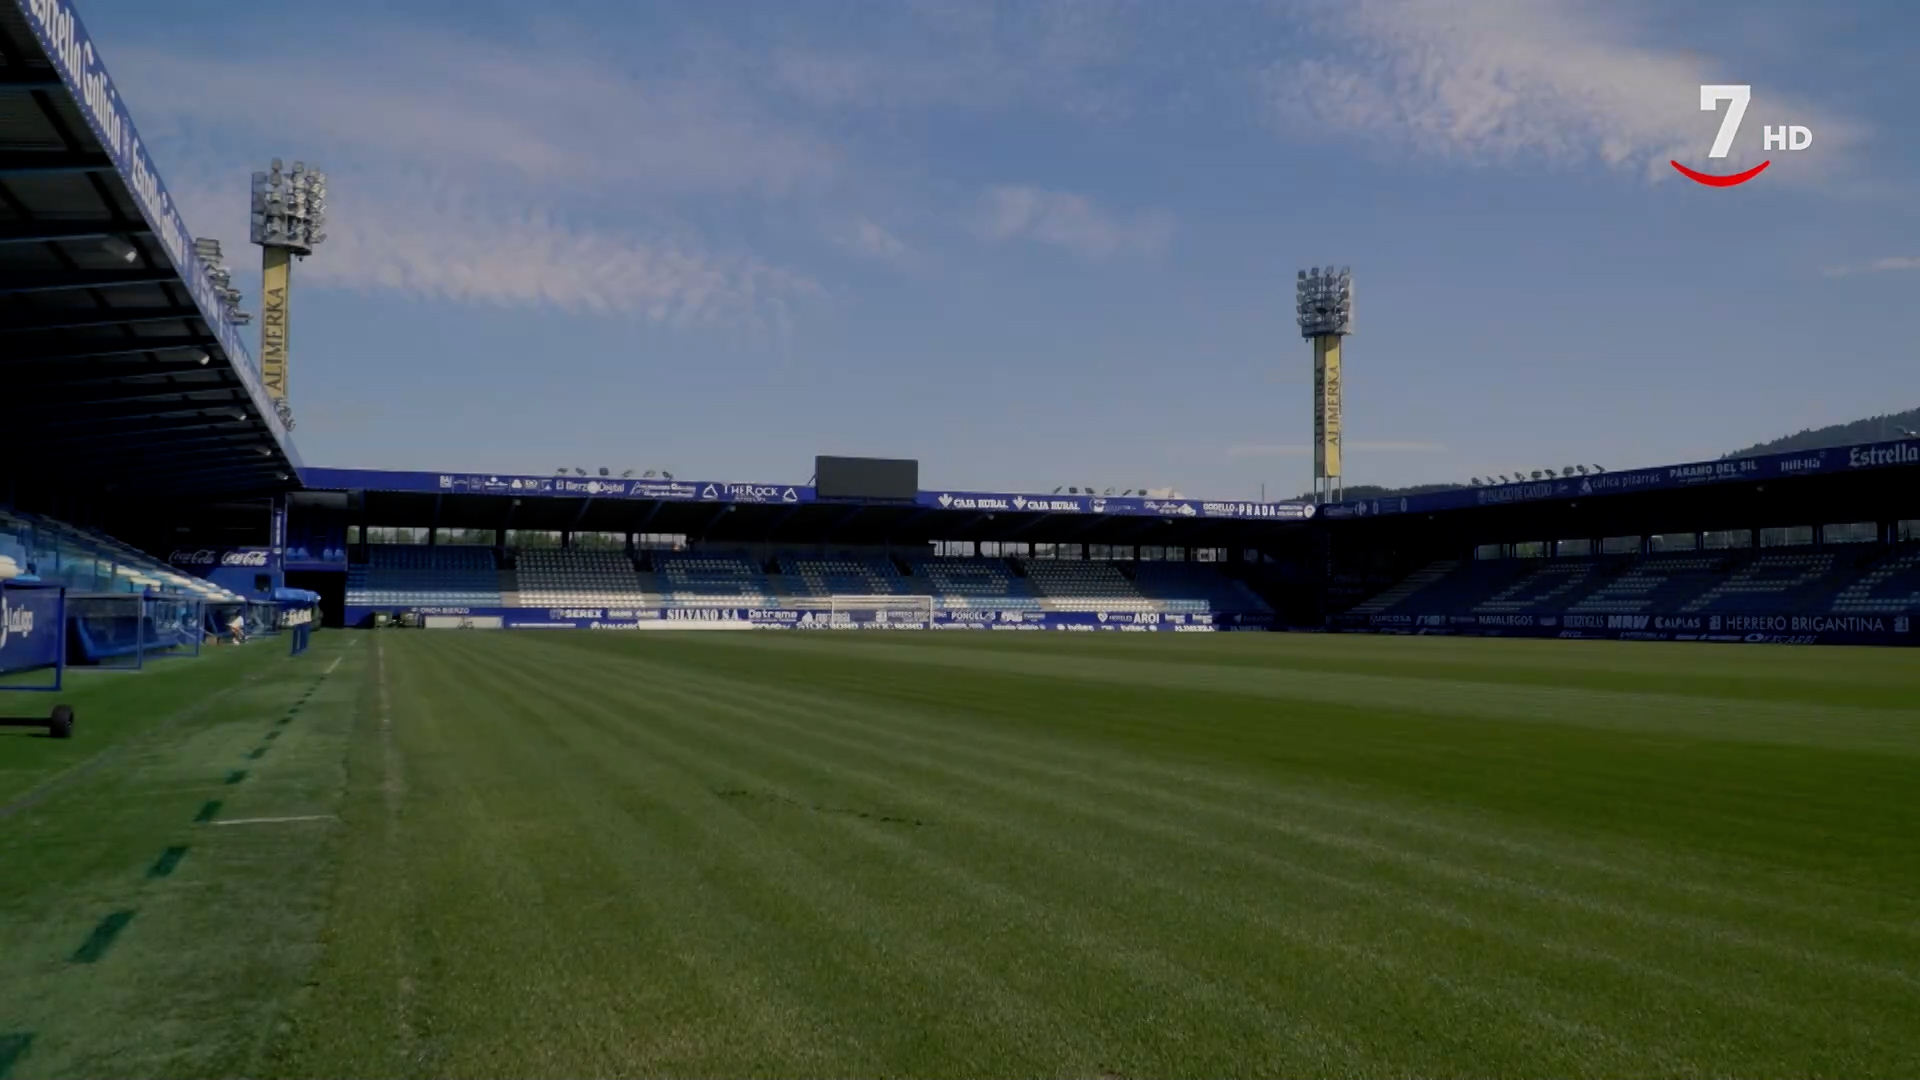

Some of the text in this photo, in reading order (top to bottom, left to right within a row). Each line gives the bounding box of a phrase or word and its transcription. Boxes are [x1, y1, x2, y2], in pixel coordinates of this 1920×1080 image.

[264, 287, 285, 391] ALIMERKA
[1327, 365, 1339, 446] ALIMERKA
[1849, 443, 1919, 467] Estrella
[1740, 460, 1759, 472] SIL
[954, 499, 1009, 509] CAJA RURAL
[1028, 501, 1080, 511] CAJA RURAL
[1239, 504, 1276, 517] PRADA
[9, 604, 33, 638] LaLiga
[666, 609, 718, 620] SILVANO
[1478, 615, 1533, 626] NAVALIEGOS
[1726, 615, 1885, 632] HERRERO BRIGANTINA
